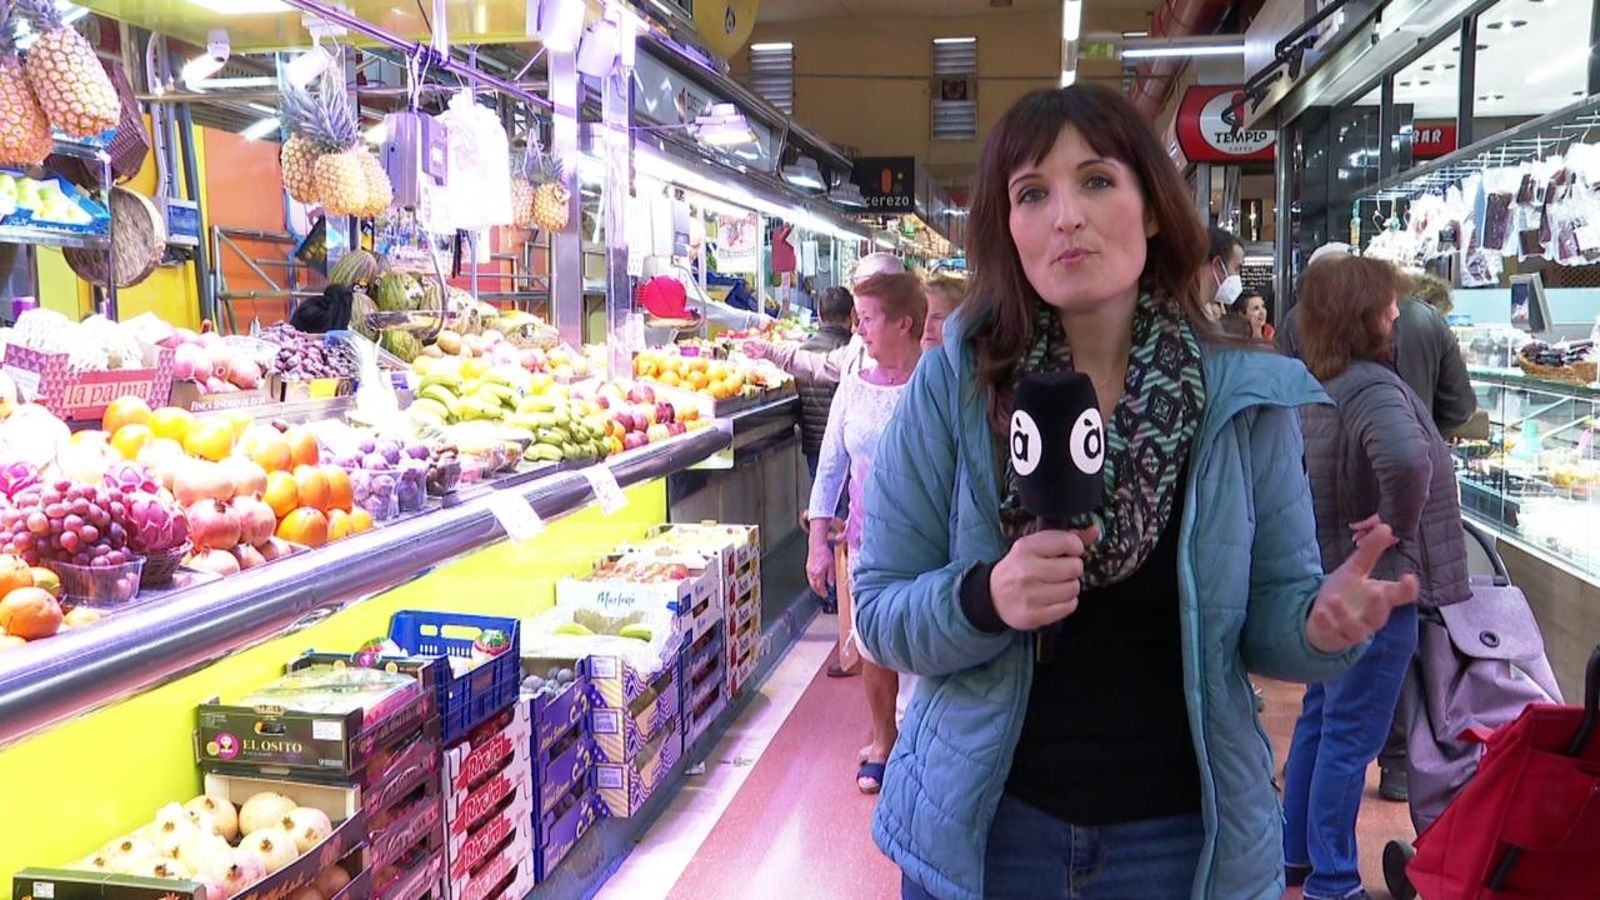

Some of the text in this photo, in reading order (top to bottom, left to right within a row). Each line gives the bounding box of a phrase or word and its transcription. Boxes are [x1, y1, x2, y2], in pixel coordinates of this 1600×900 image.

[1214, 131, 1267, 143] TEMPLO
[1413, 129, 1442, 143] BAR
[864, 195, 910, 207] cerezo
[67, 380, 148, 406] la palma
[1013, 417, 1029, 462] à
[1083, 418, 1101, 459] à
[242, 739, 259, 751] EL
[260, 741, 303, 753] OSITO
